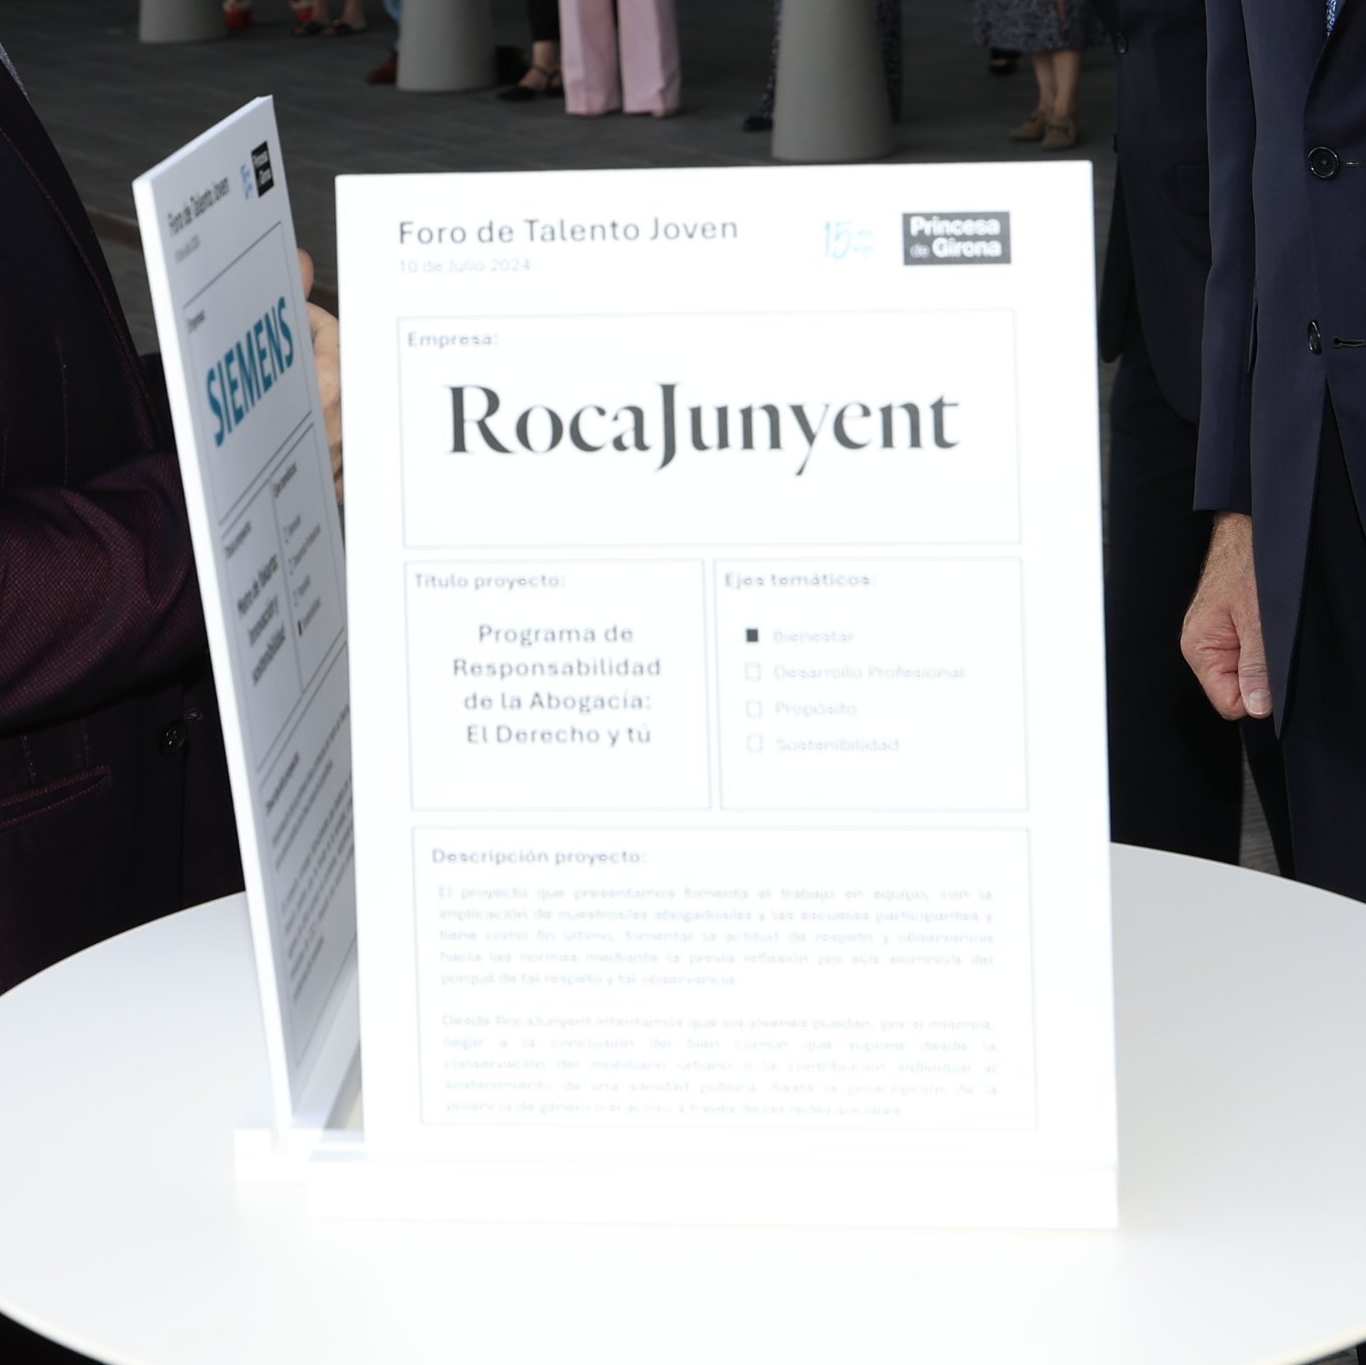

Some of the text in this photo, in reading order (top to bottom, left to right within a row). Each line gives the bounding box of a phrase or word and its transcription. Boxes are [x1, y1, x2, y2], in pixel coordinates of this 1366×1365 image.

[399, 217, 737, 245] Foro de Talento Joven
[909, 216, 1001, 236] Princesa
[910, 237, 1002, 258] de Girona
[400, 260, 418, 273] 10
[423, 260, 443, 273] de
[491, 258, 531, 272] 2024
[407, 331, 499, 351] Empresa:
[206, 296, 294, 447] SIEMENS
[446, 382, 960, 477] RocaJunyent
[473, 574, 566, 592] proyecto:
[724, 570, 876, 592] Ejes temáticos:
[479, 624, 633, 647] Programa de
[453, 658, 660, 680] Responsabilidad
[464, 691, 650, 714] de la Abogacía:
[467, 724, 650, 748] El Derecho y tú
[431, 847, 647, 868] Descripción proyecto:
